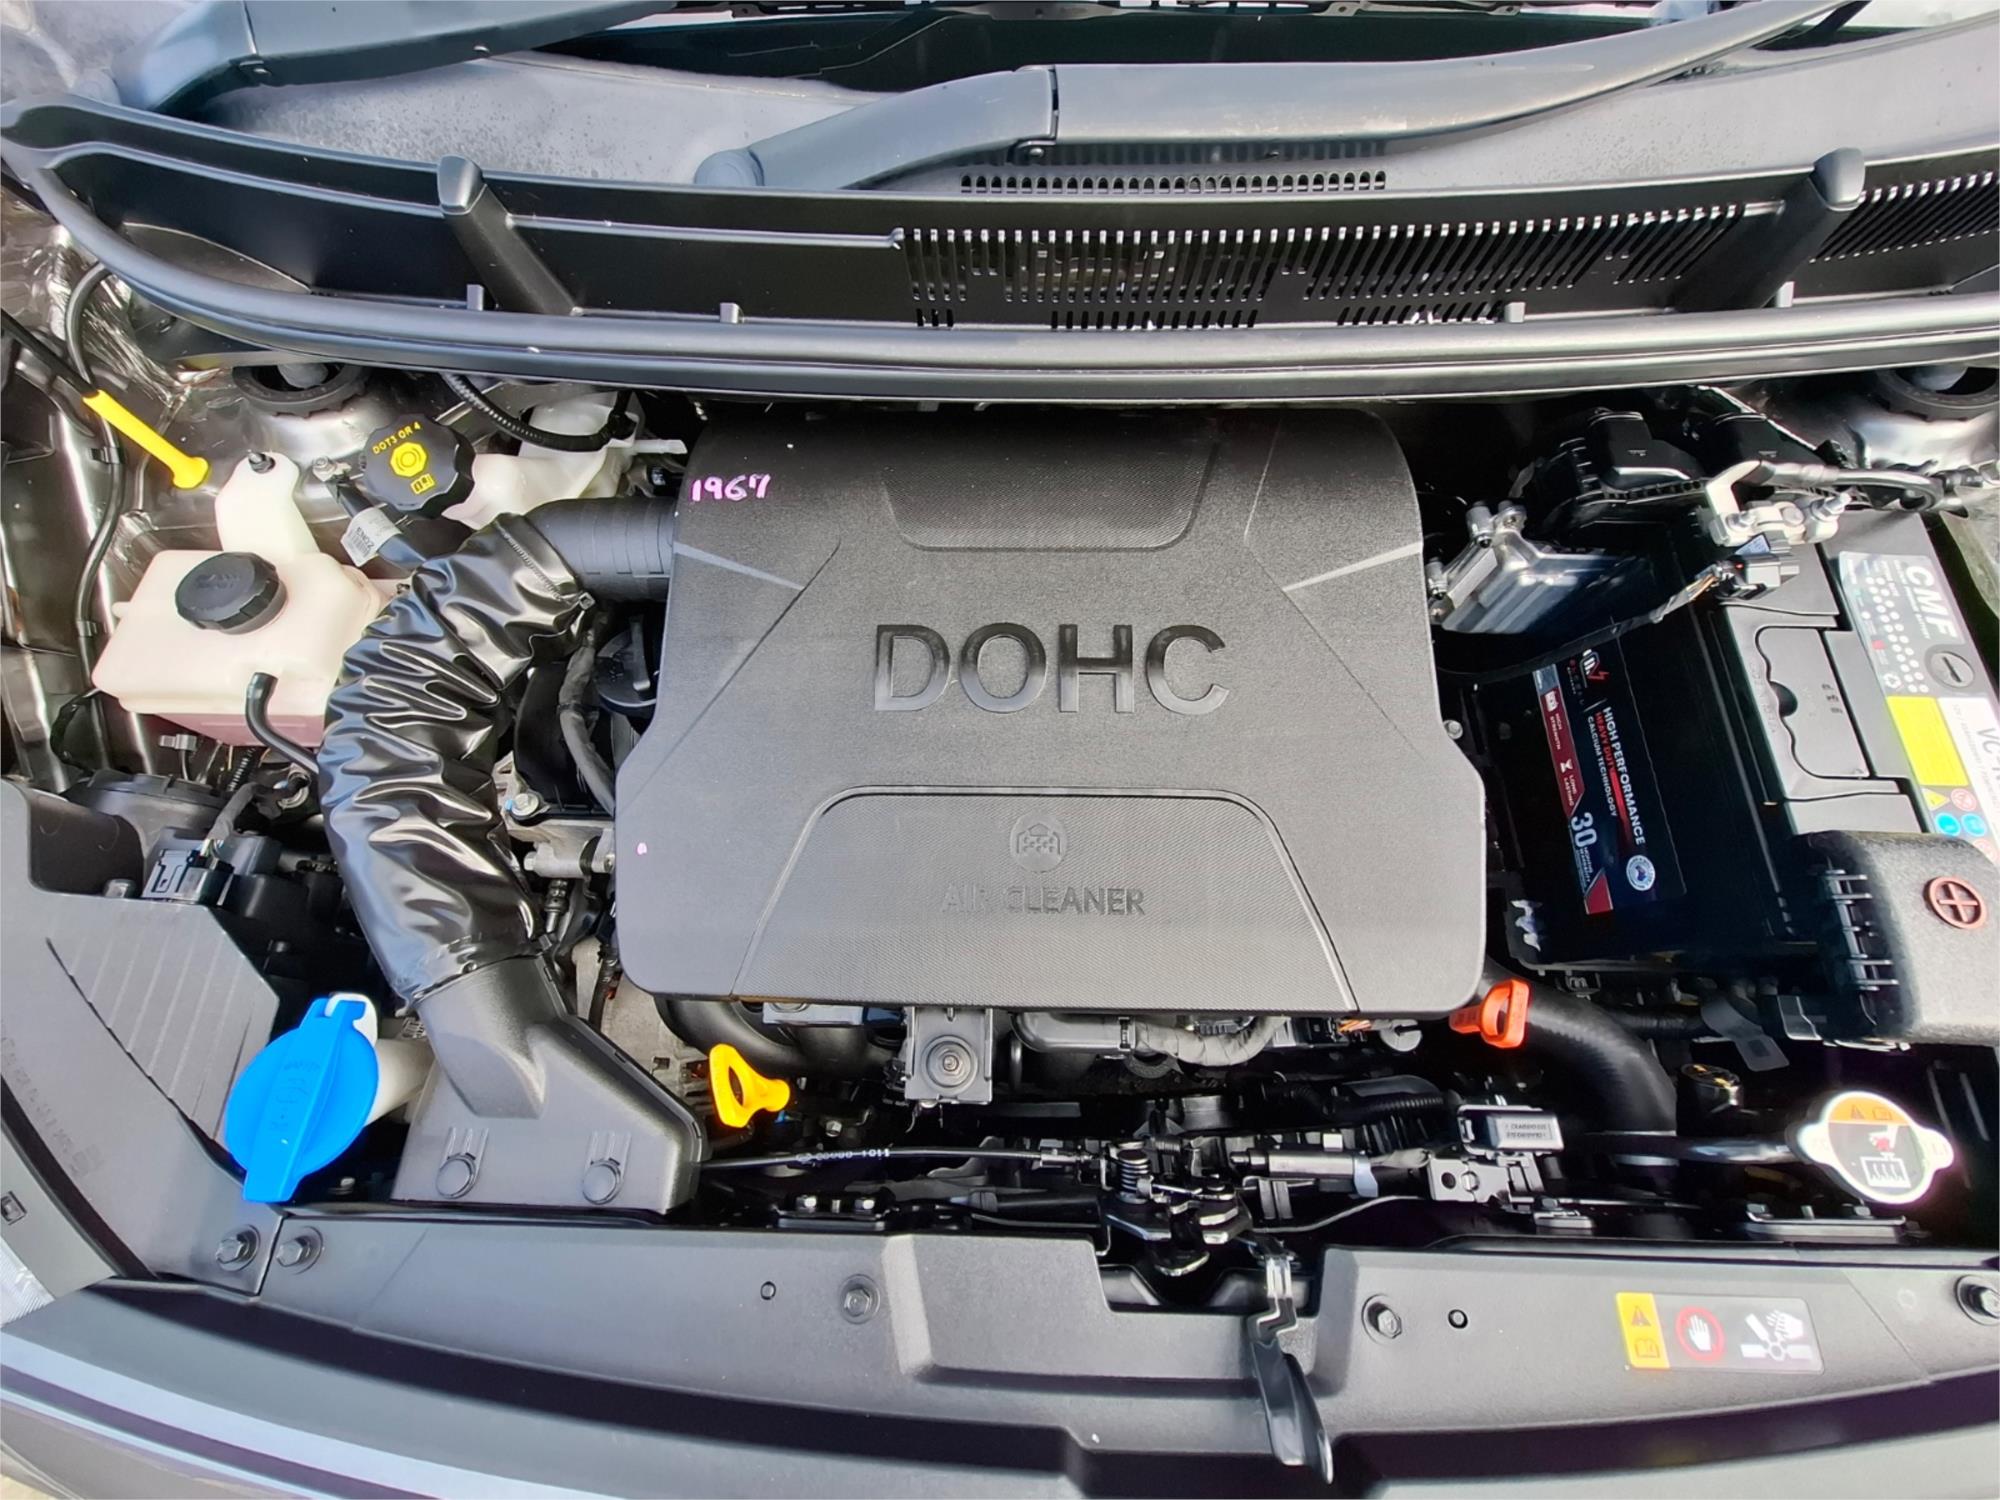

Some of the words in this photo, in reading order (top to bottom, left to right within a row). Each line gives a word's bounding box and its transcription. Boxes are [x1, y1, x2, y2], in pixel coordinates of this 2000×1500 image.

[372, 435, 398, 455] DOT3
[398, 425, 413, 439] OR
[414, 421, 421, 430] 4
[692, 473, 771, 502] 1967
[1906, 565, 1959, 639] CMF
[875, 622, 1230, 715] DOHC
[1587, 715, 1602, 756] CALCIUM
[1598, 757, 1618, 817] TECHNOLOGY
[1603, 706, 1619, 740] HIGH
[1611, 741, 1646, 845] PERFORMANCE
[1570, 812, 1598, 848] 30
[1005, 884, 1146, 916] CLEANER
